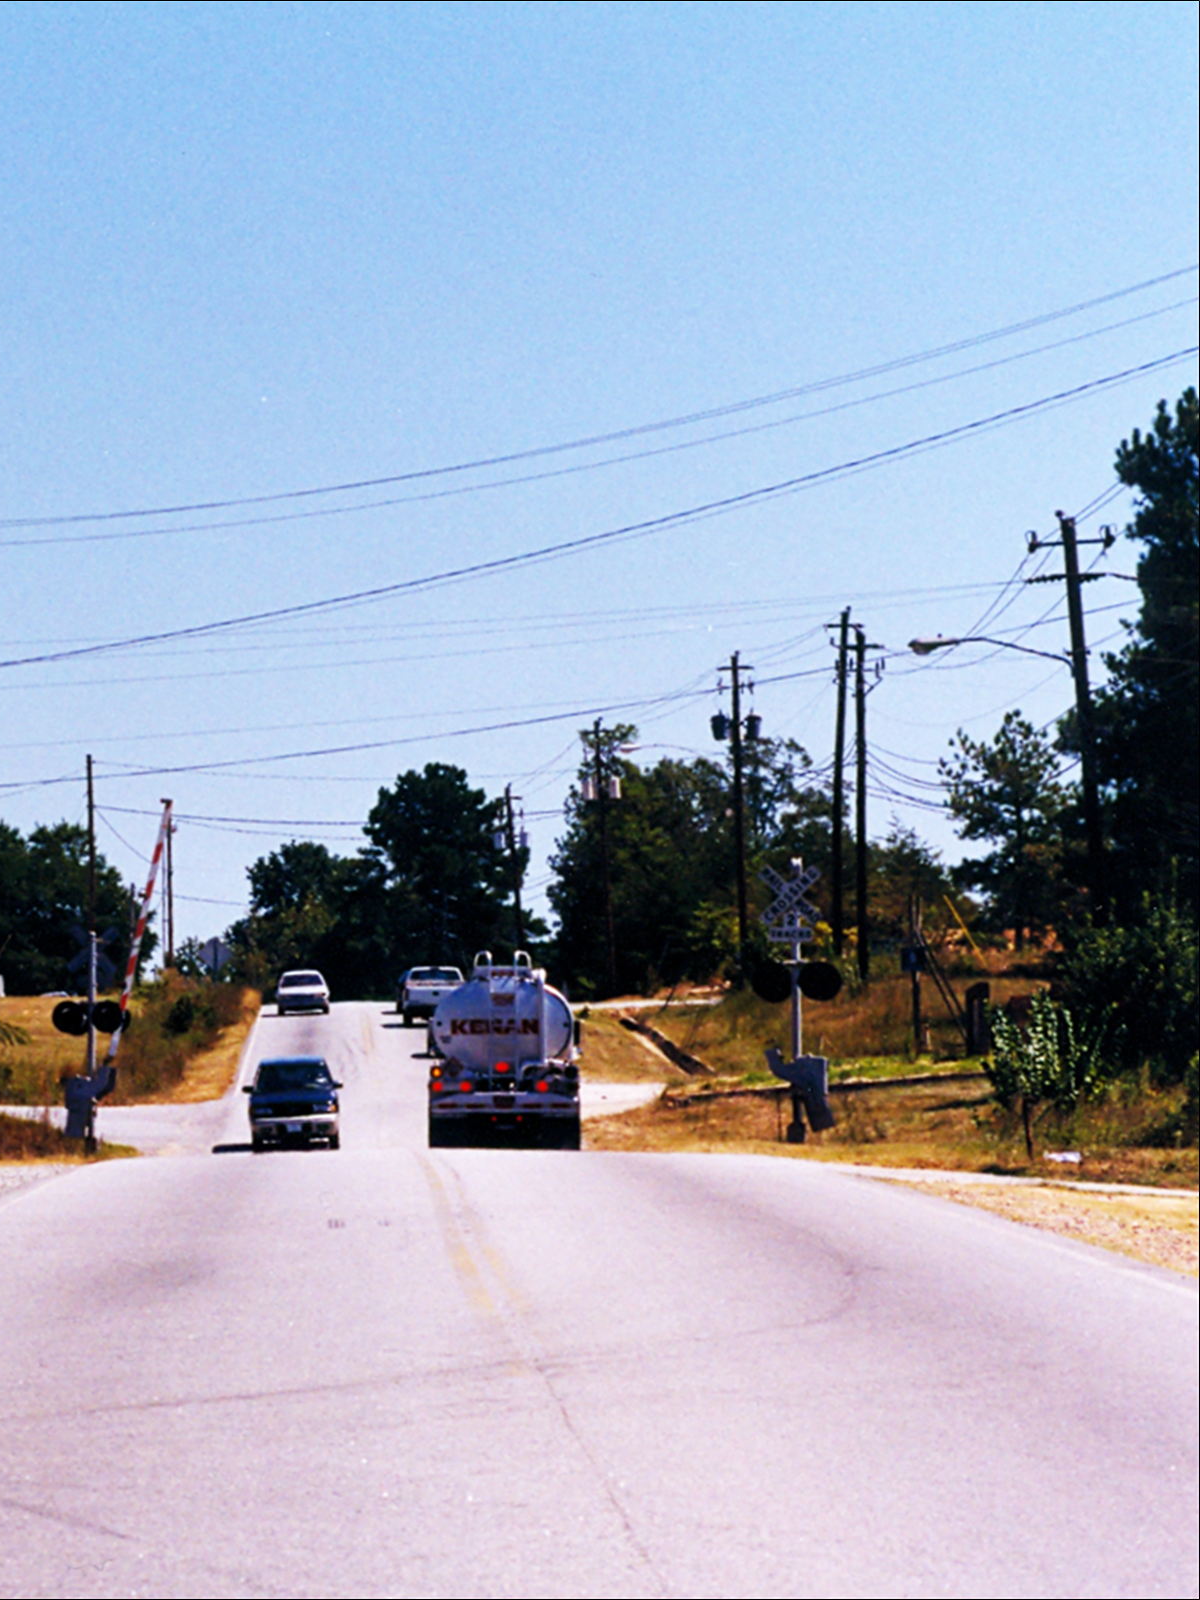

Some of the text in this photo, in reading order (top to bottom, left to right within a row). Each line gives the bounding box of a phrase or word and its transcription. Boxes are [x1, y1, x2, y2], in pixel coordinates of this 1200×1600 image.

[761, 866, 784, 892] RAIL
[764, 869, 818, 922] CROSSING
[787, 913, 796, 926] 2
[770, 929, 812, 939] TRACKS
